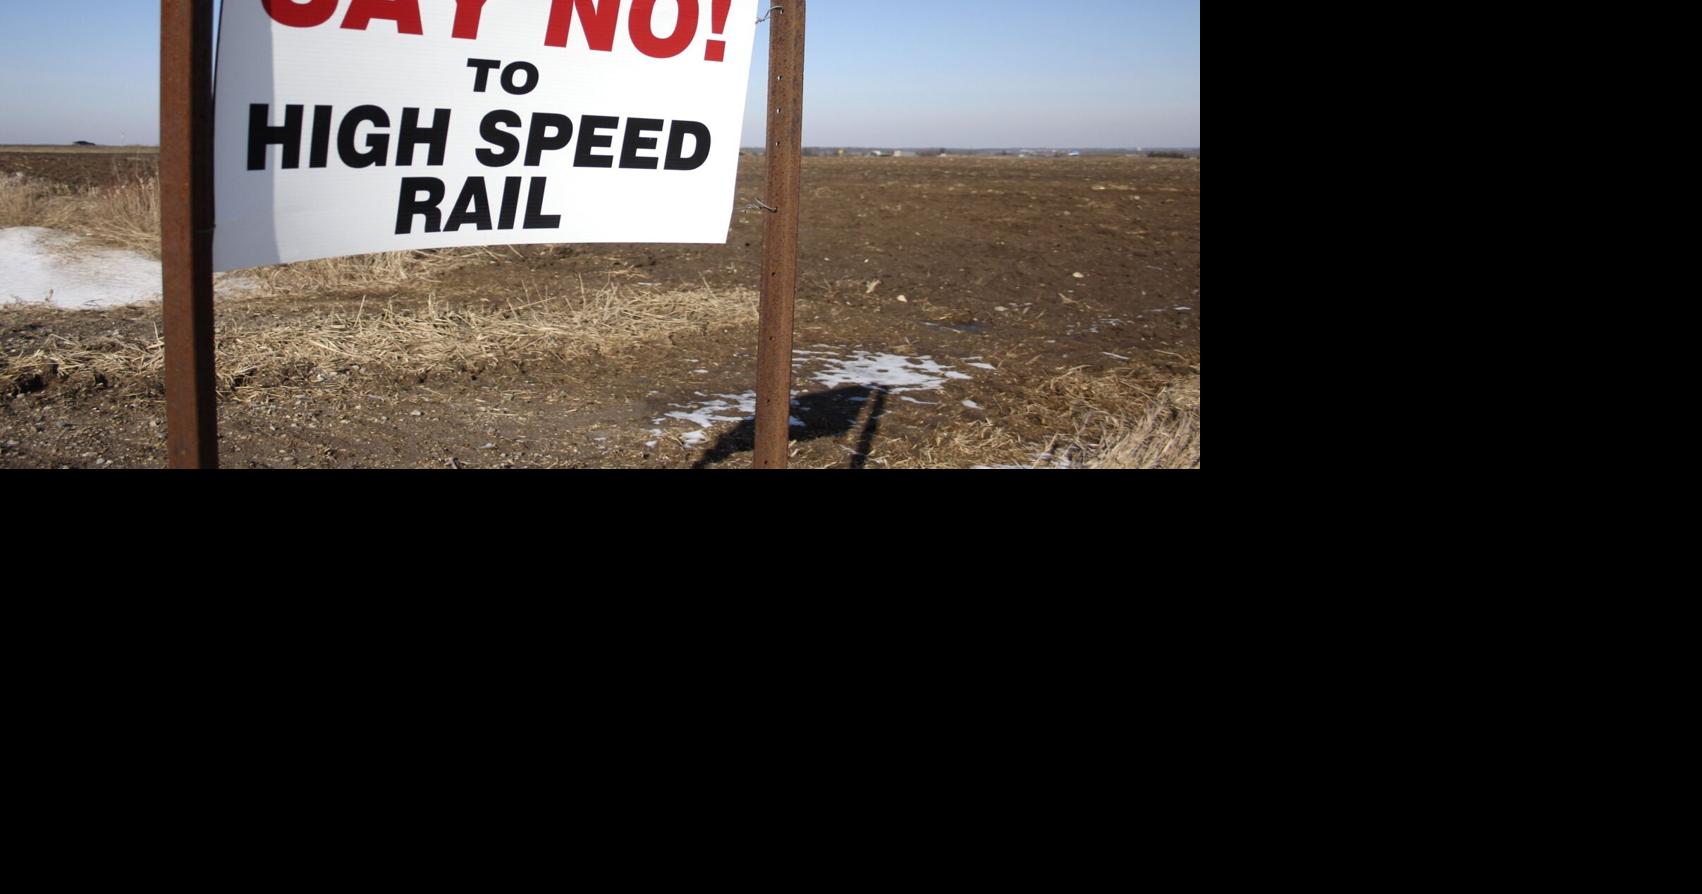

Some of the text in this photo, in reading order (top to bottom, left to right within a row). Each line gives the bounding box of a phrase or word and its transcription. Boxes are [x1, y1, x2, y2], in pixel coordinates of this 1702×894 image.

[544, 0, 732, 62] NO!
[466, 58, 539, 95] TO
[246, 103, 712, 172] HIGH SPEED
[394, 175, 562, 235] RAIL
